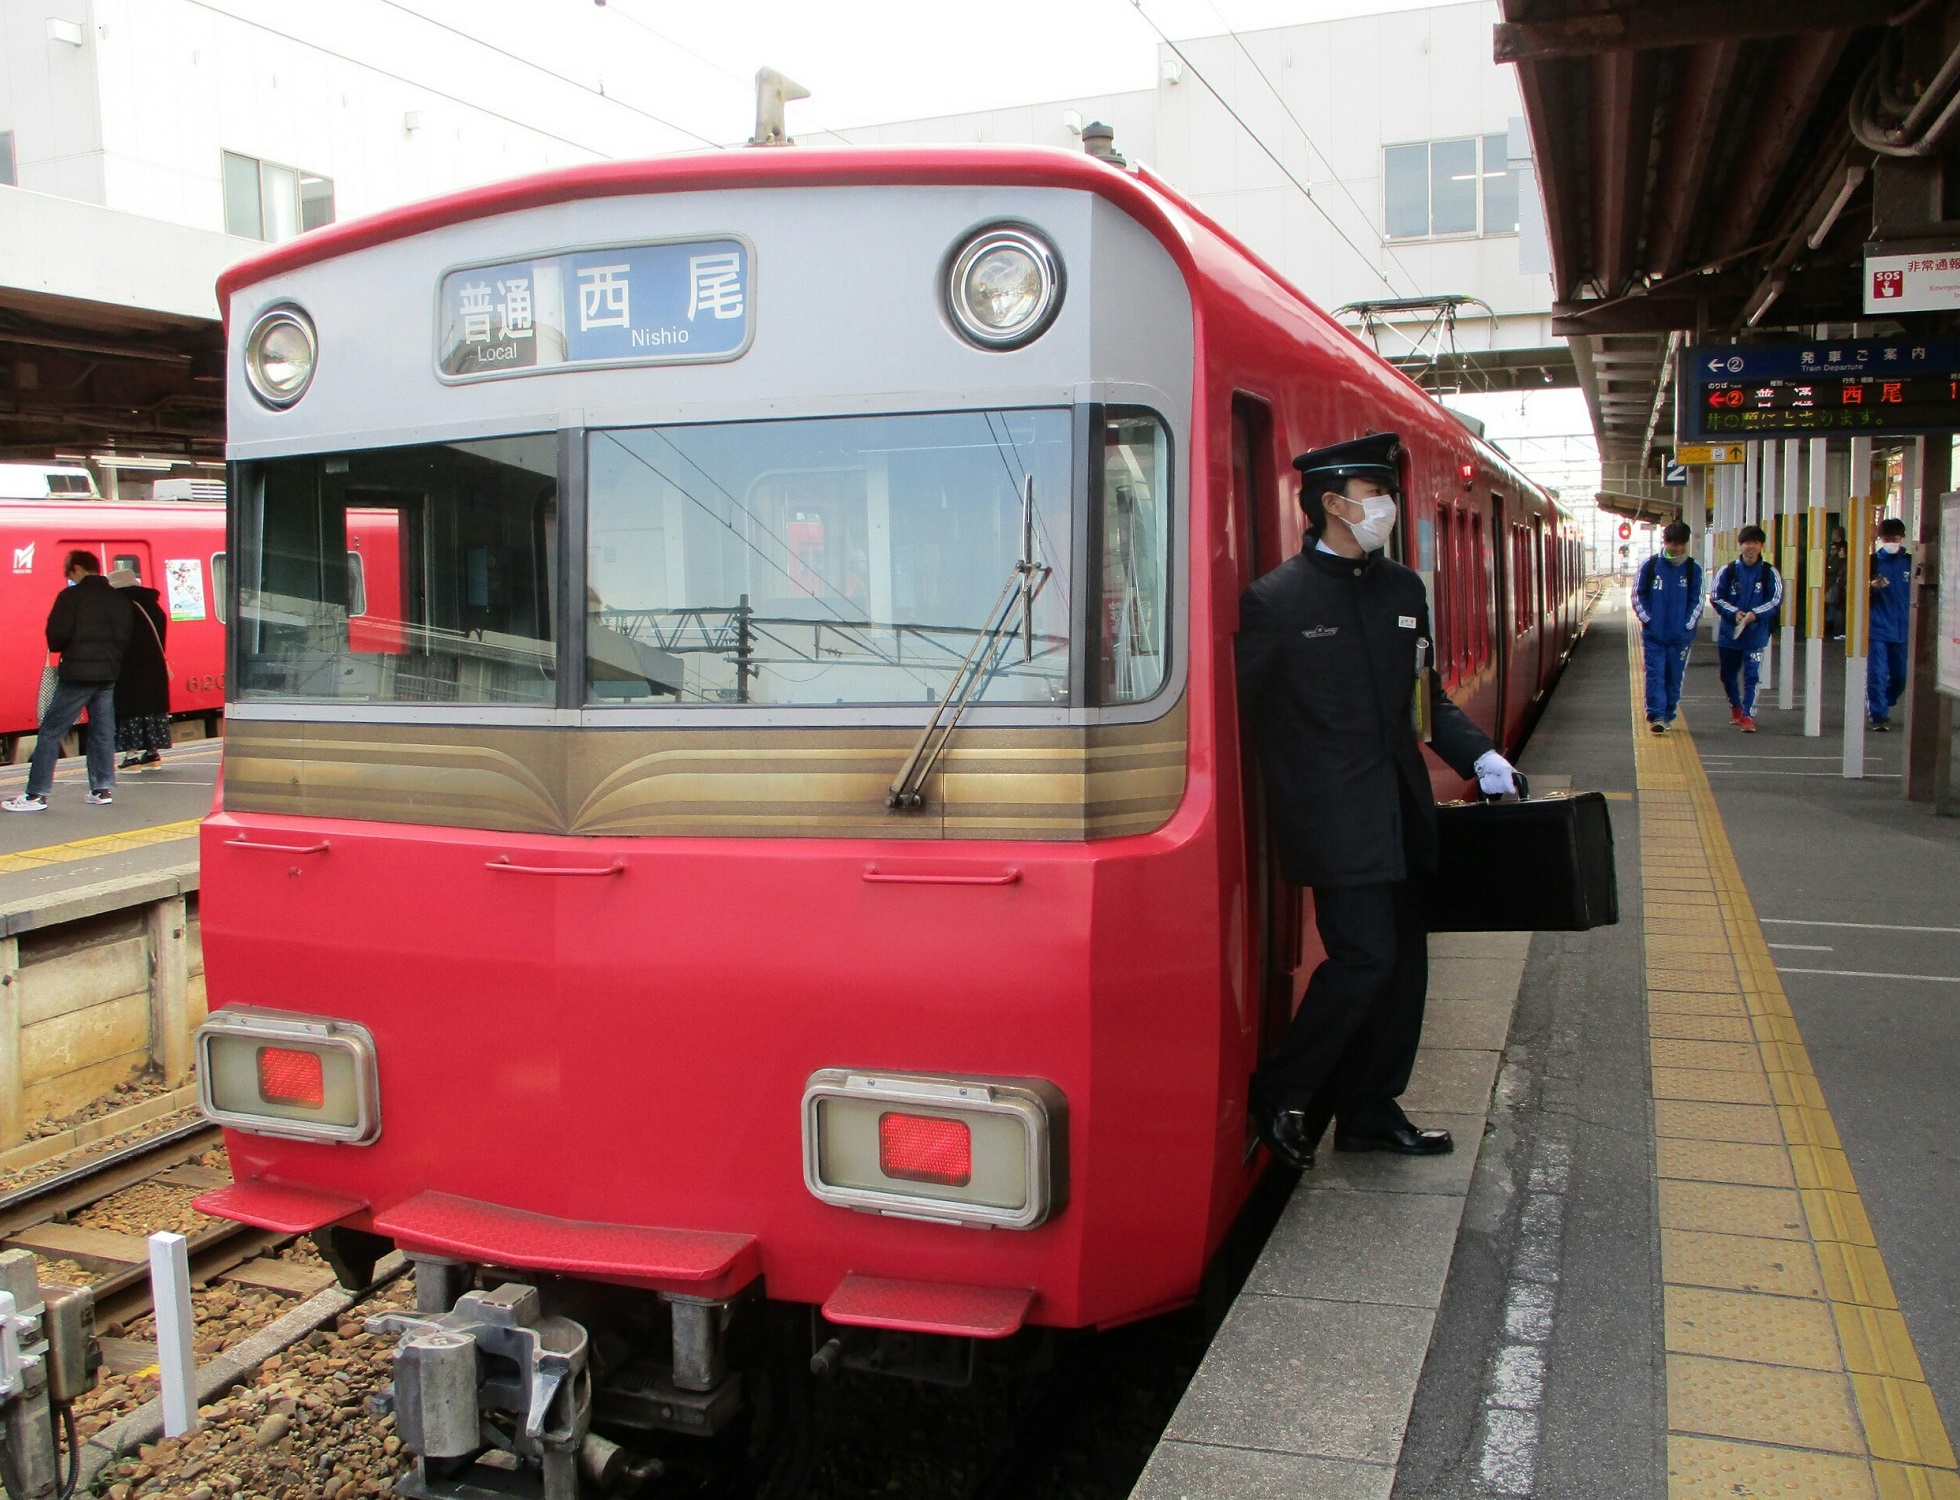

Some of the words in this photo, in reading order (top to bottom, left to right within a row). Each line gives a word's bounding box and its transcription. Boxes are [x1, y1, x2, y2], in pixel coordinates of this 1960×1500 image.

[1876, 271, 1901, 281] SOS
[576, 253, 744, 332] 西尾
[459, 277, 534, 344] 普通
[631, 326, 690, 347] Nishio
[477, 343, 517, 362] Local
[1801, 364, 1821, 372] Train
[1823, 363, 1864, 372] Departure
[1842, 383, 1904, 404] 西尾
[1666, 459, 1686, 481] 2
